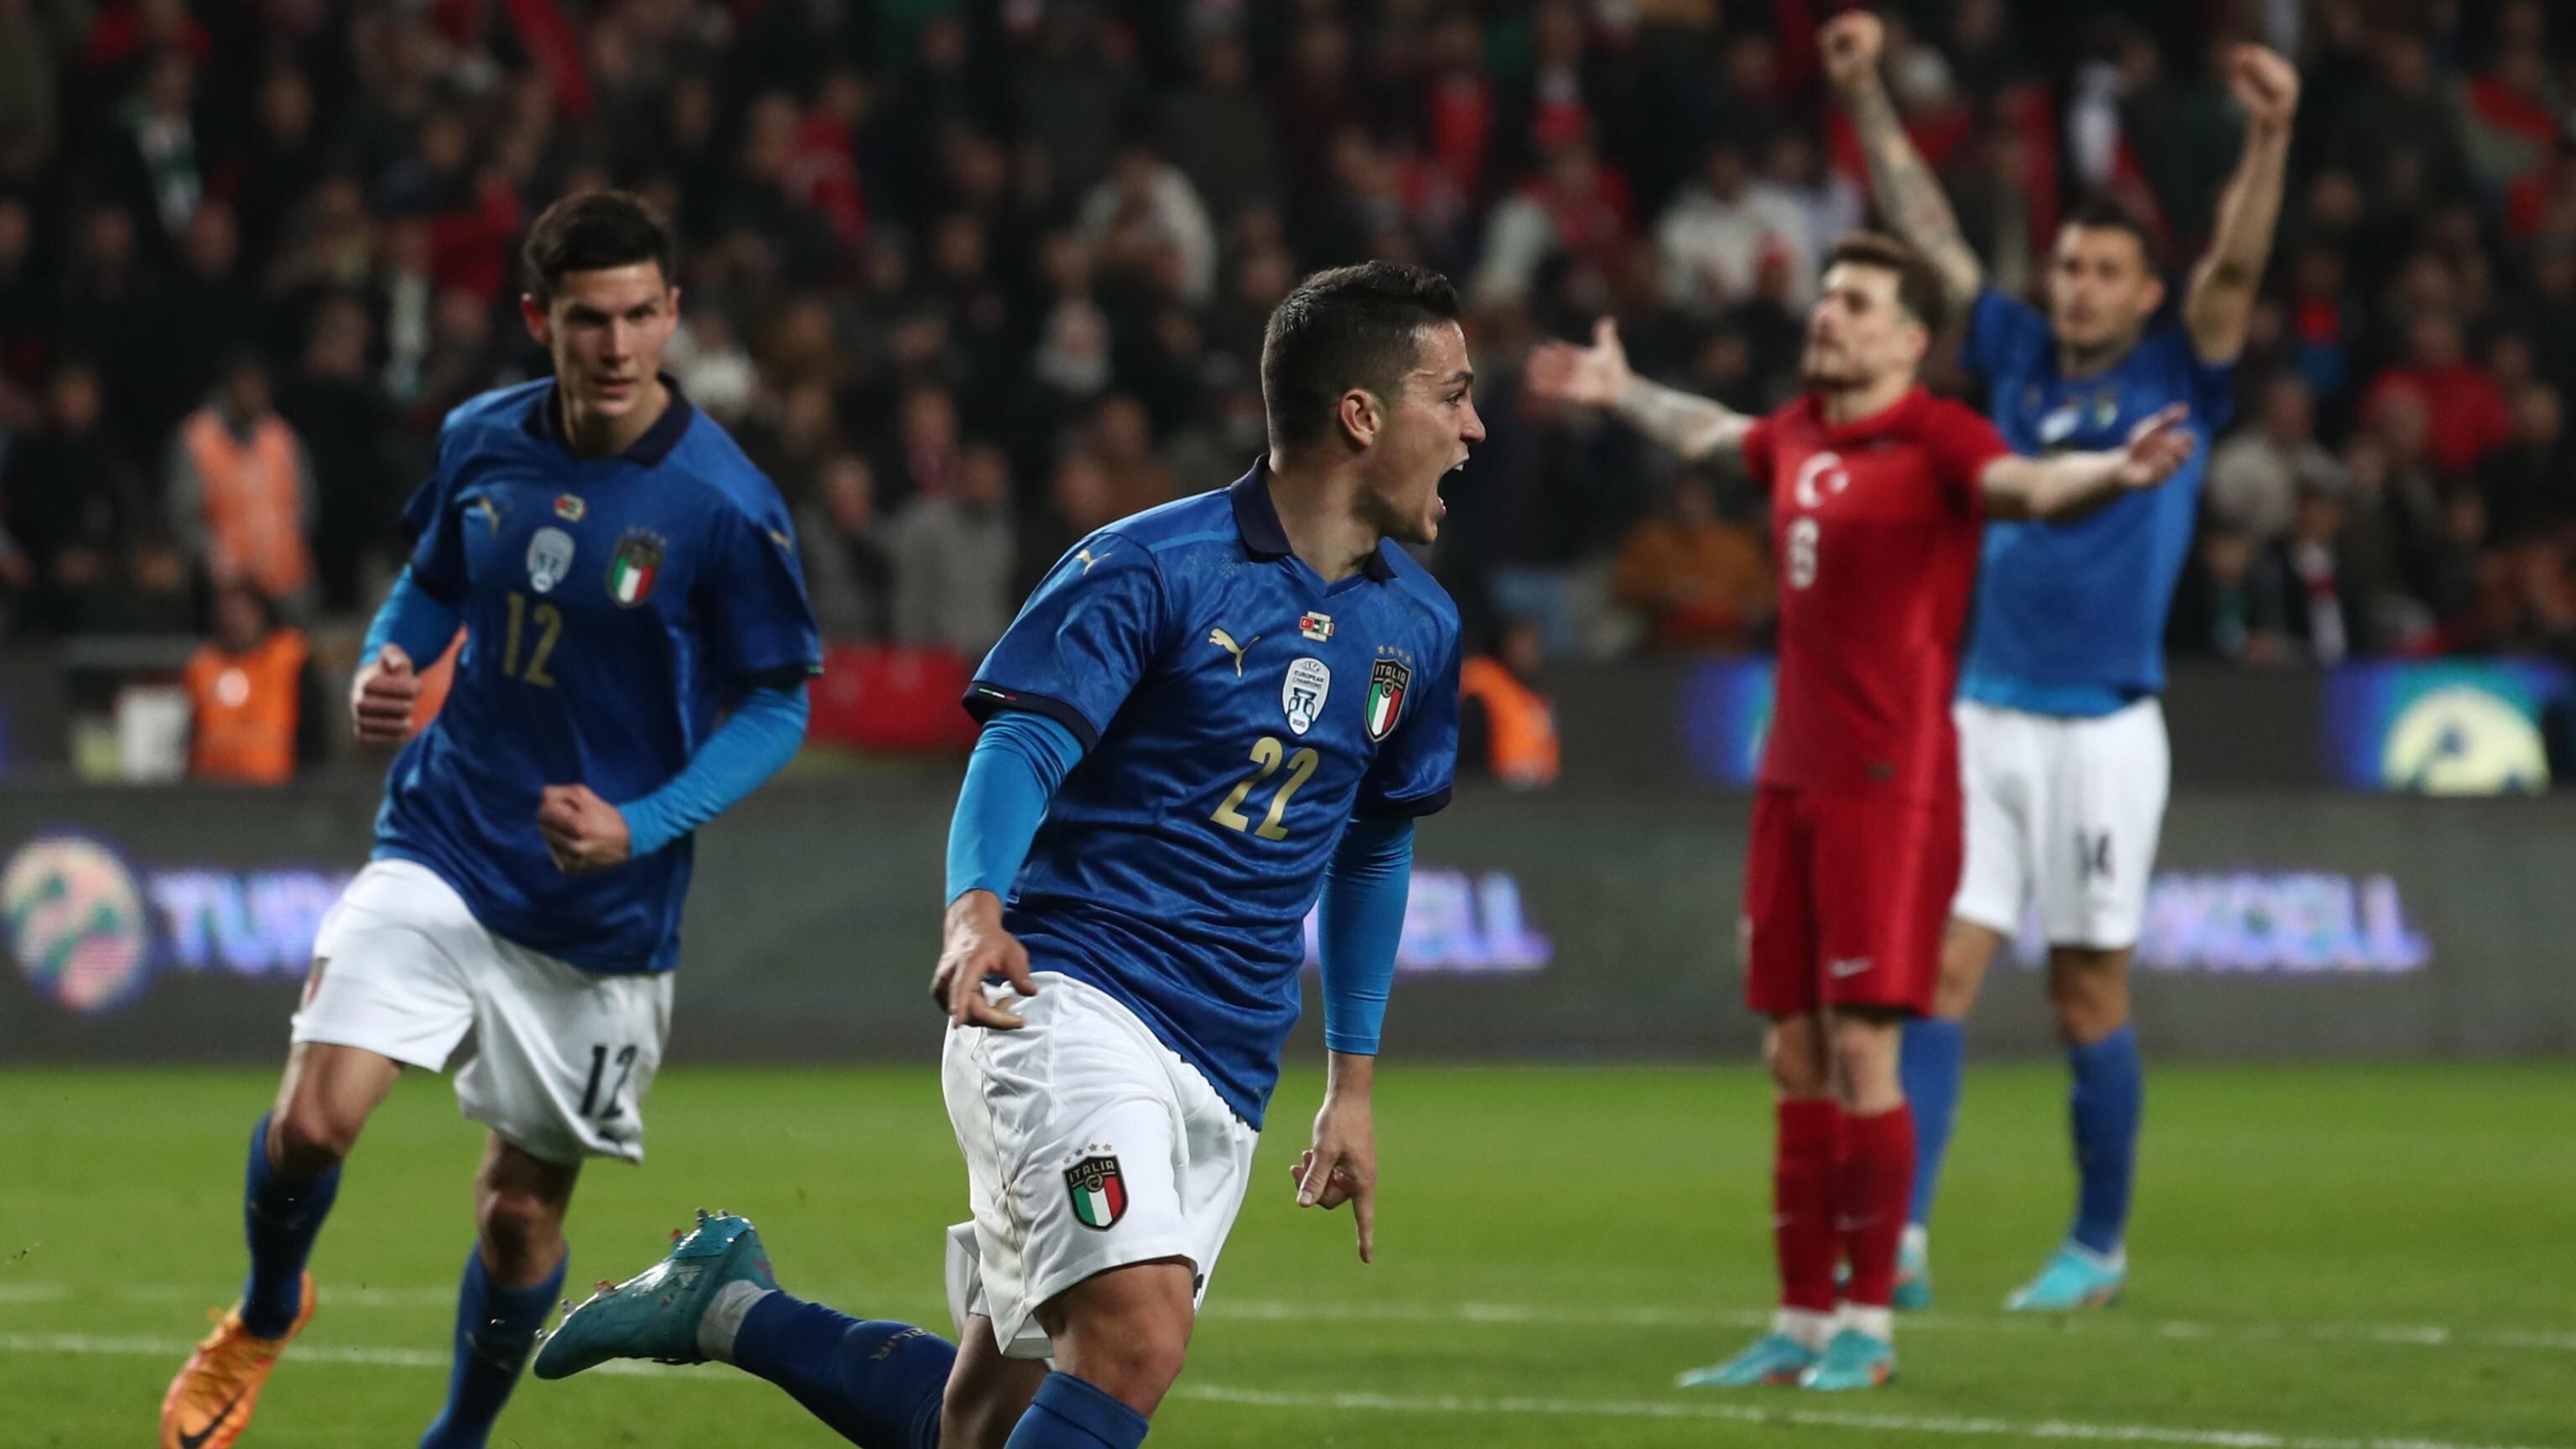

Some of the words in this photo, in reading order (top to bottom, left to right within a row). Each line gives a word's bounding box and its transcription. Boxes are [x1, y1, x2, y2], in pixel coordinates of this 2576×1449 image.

[504, 592, 562, 688] 12
[1294, 670, 1324, 683] EUROPEAN
[1375, 665, 1407, 684] ITALIA
[1209, 736, 1319, 841] 22
[149, 869, 356, 972] TUR
[580, 1045, 638, 1119] 12
[1069, 1160, 1115, 1183] ITALIA
